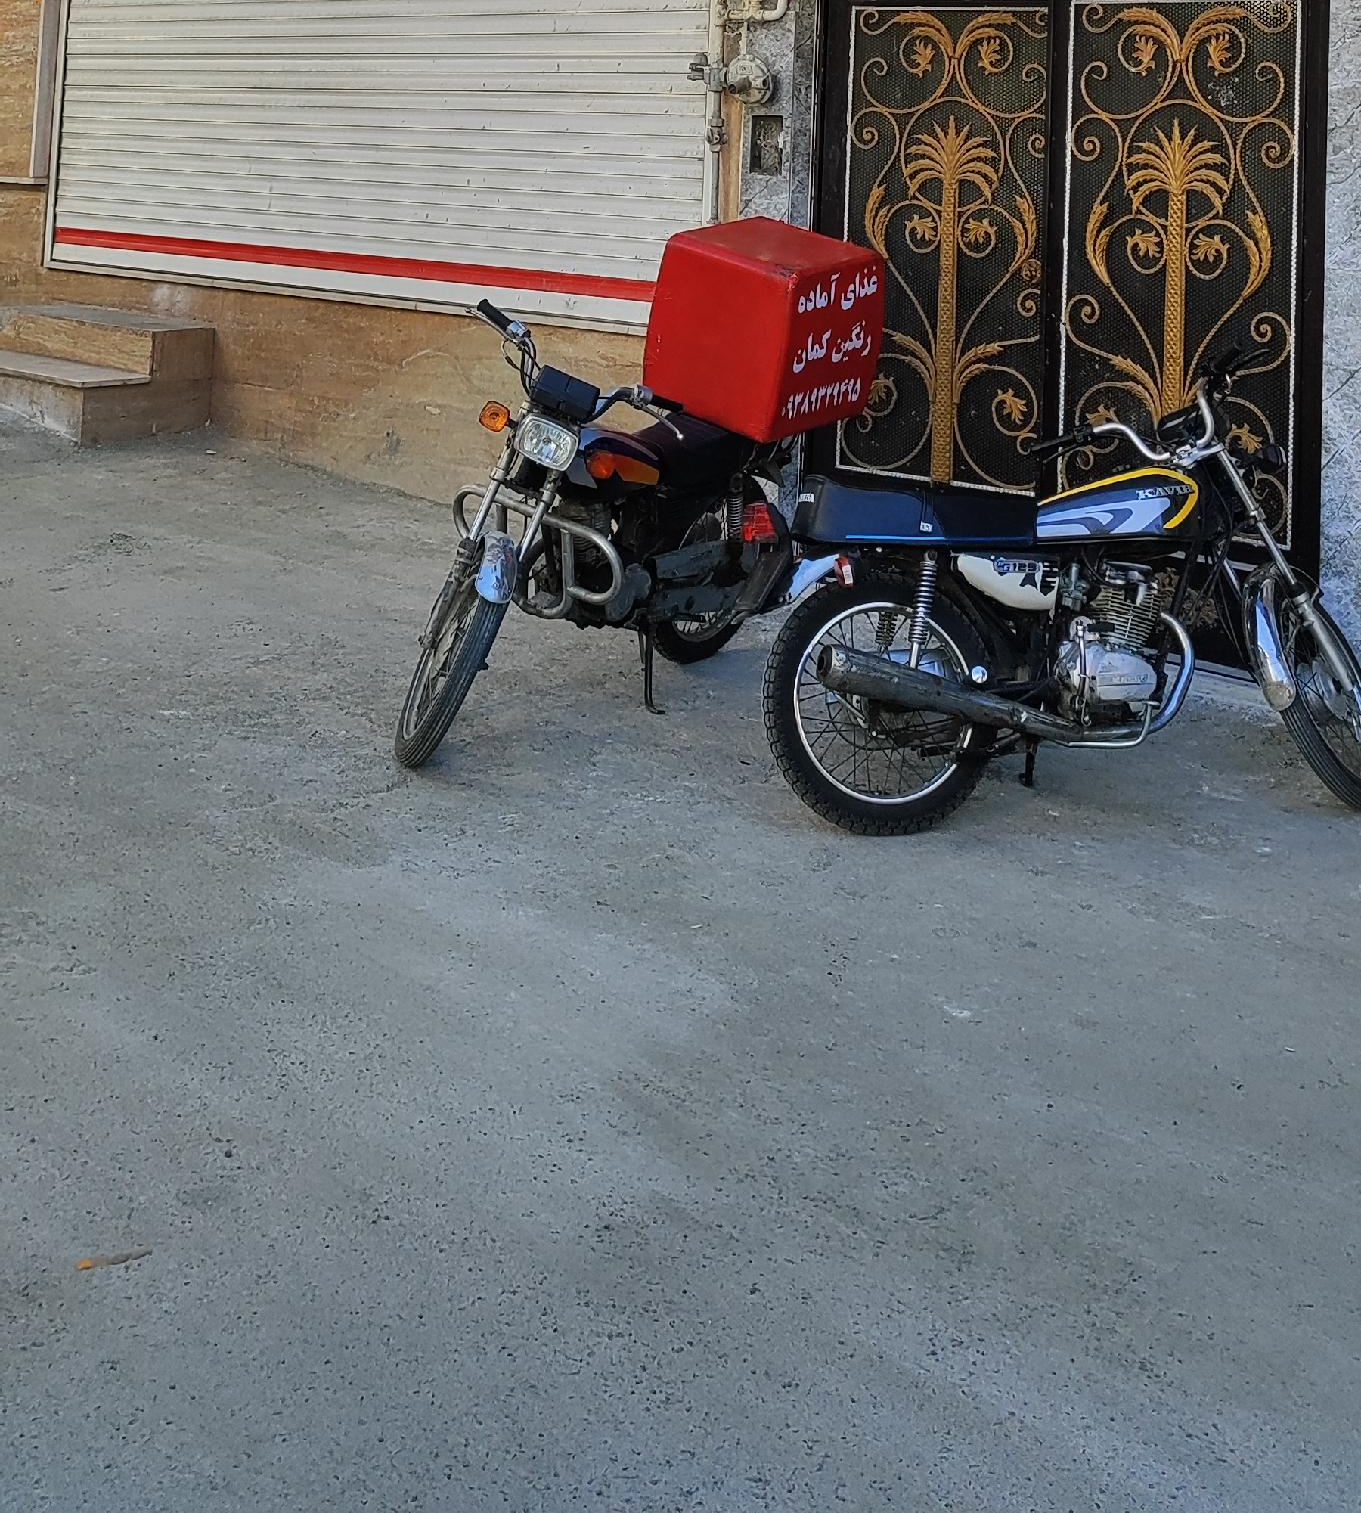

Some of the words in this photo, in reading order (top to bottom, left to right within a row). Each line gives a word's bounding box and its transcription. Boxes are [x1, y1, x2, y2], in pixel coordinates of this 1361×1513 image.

[797, 272, 840, 313] آماده
[841, 266, 878, 310] غذای
[792, 329, 832, 373] کمان
[831, 320, 871, 362] رنگین
